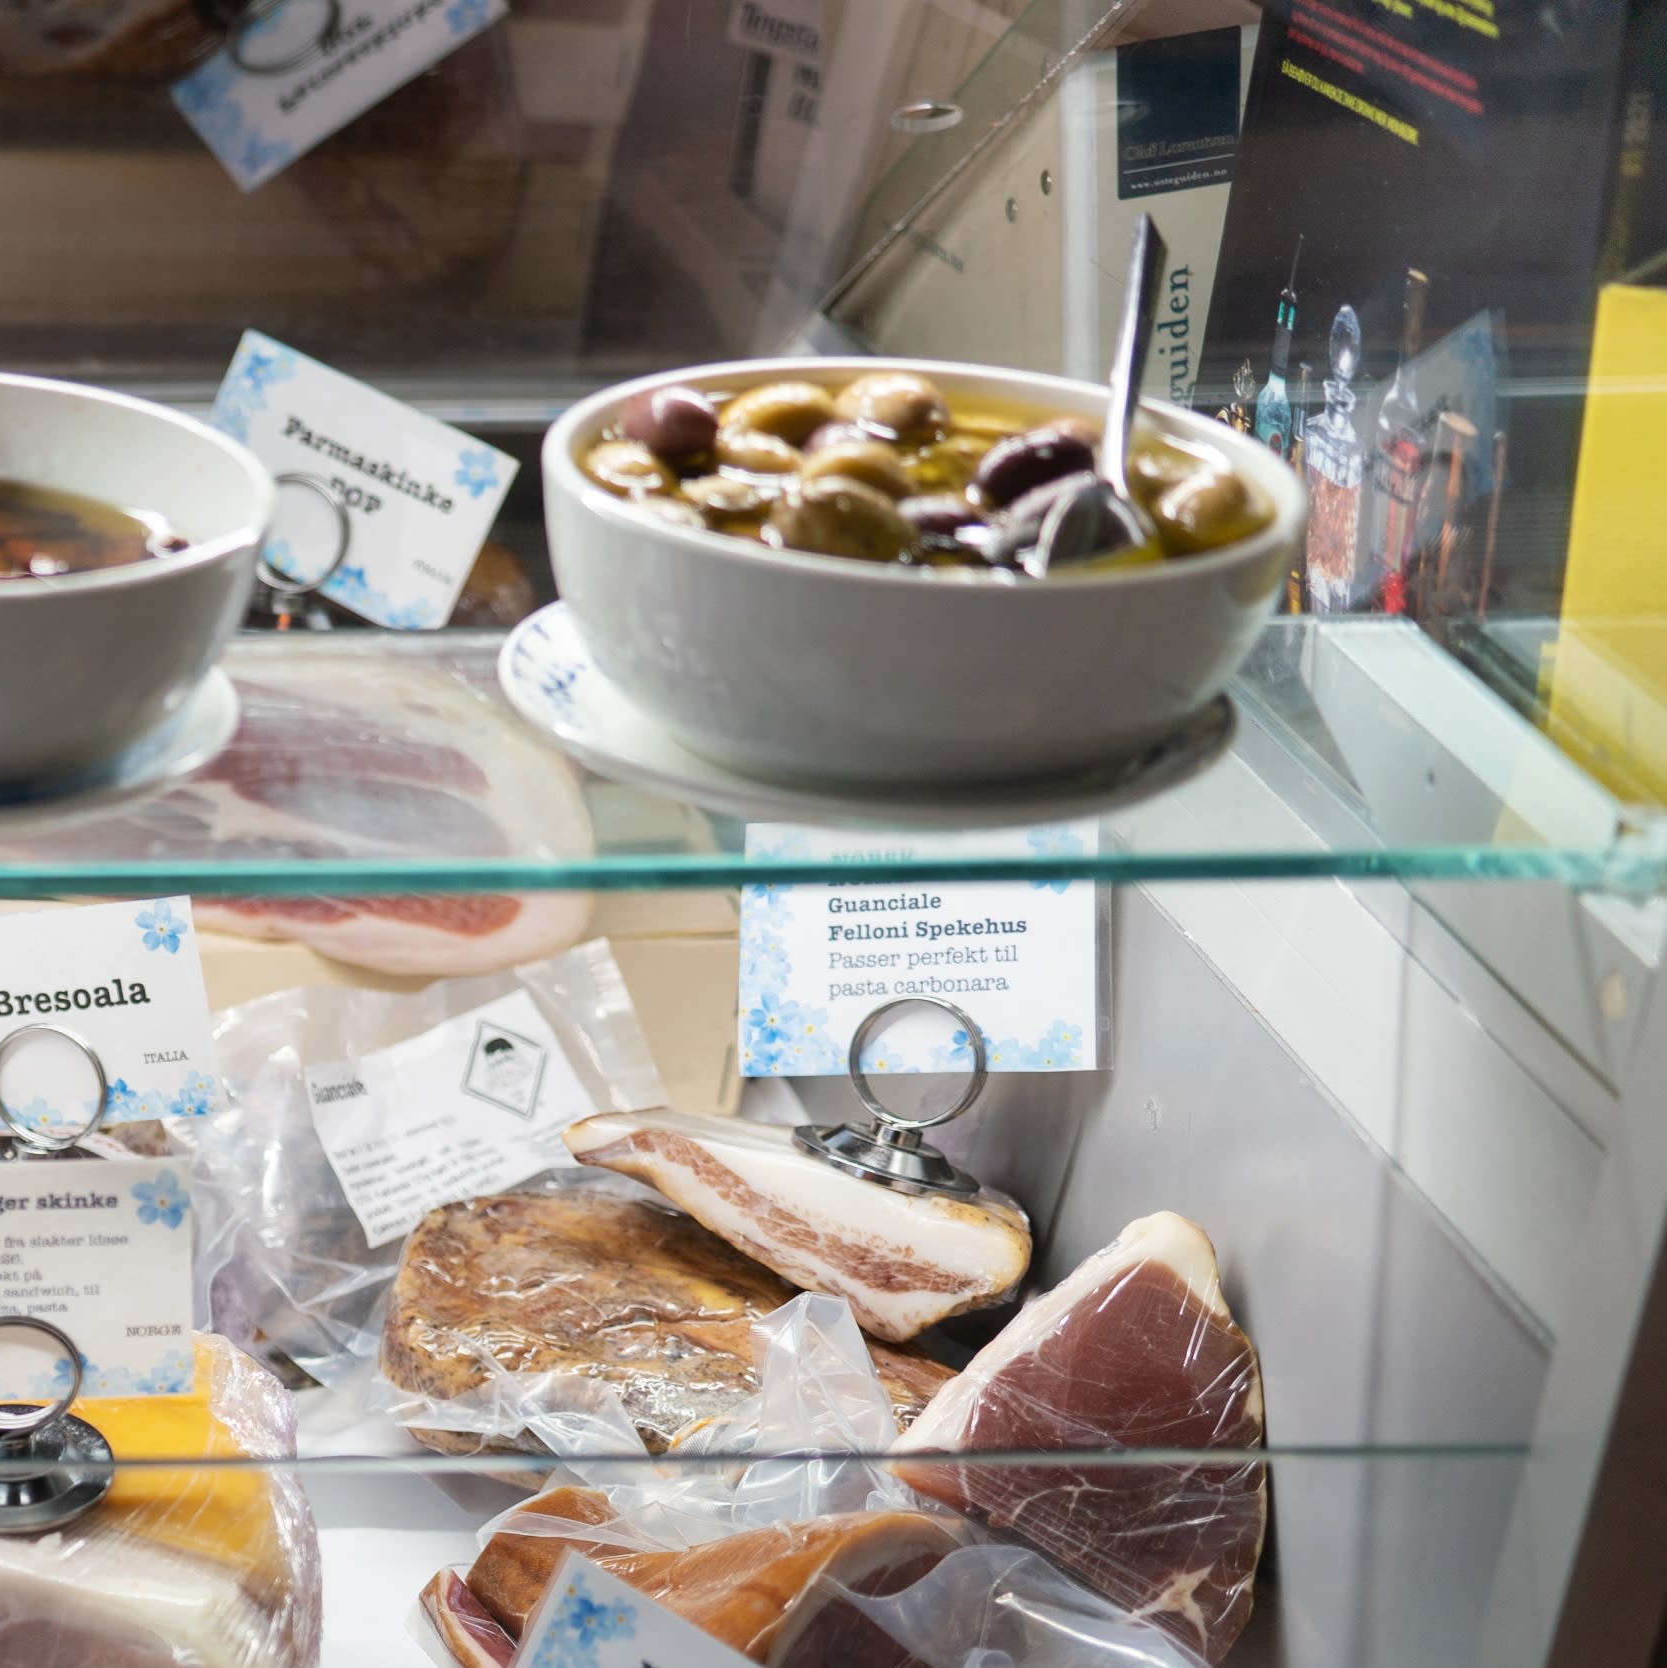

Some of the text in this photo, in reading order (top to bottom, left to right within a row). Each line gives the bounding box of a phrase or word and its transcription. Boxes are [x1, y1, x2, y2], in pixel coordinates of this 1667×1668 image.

[283, 416, 453, 514] Parmaskinke
[828, 893, 942, 914] Guanciale
[828, 917, 1028, 942] Felloni Spekehus
[829, 945, 1019, 970] Passer perfekt til
[829, 975, 1009, 1001] pasta carbonara
[143, 1050, 189, 1064] ITALIA
[36, 1192, 119, 1211] skinke
[4, 1236, 26, 1247] fra
[29, 1234, 84, 1247] slakter
[2, 1284, 77, 1298] sandwich,
[26, 1300, 68, 1317] pasta
[126, 1326, 182, 1337] NORGE
